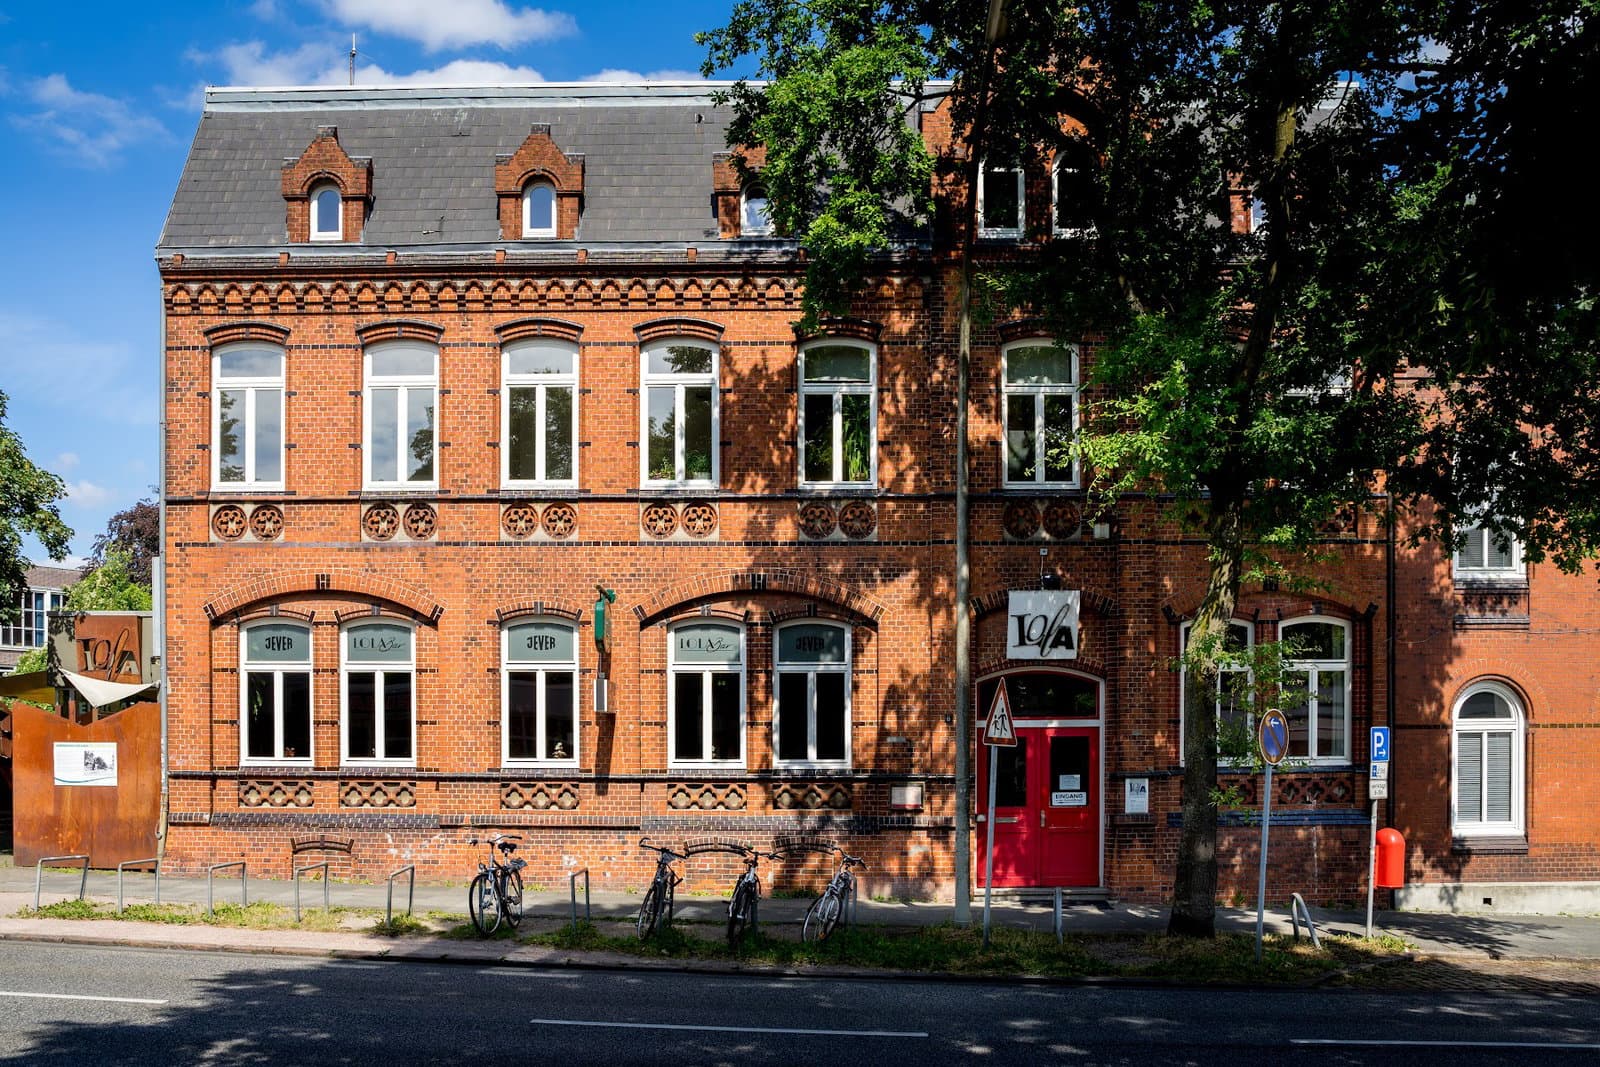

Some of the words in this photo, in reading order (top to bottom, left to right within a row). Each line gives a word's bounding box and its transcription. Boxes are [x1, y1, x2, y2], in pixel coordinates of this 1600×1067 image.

[265, 636, 293, 651] JEVER
[526, 635, 556, 651] JEVER
[795, 635, 825, 652] JEVER
[1373, 731, 1385, 758] P
